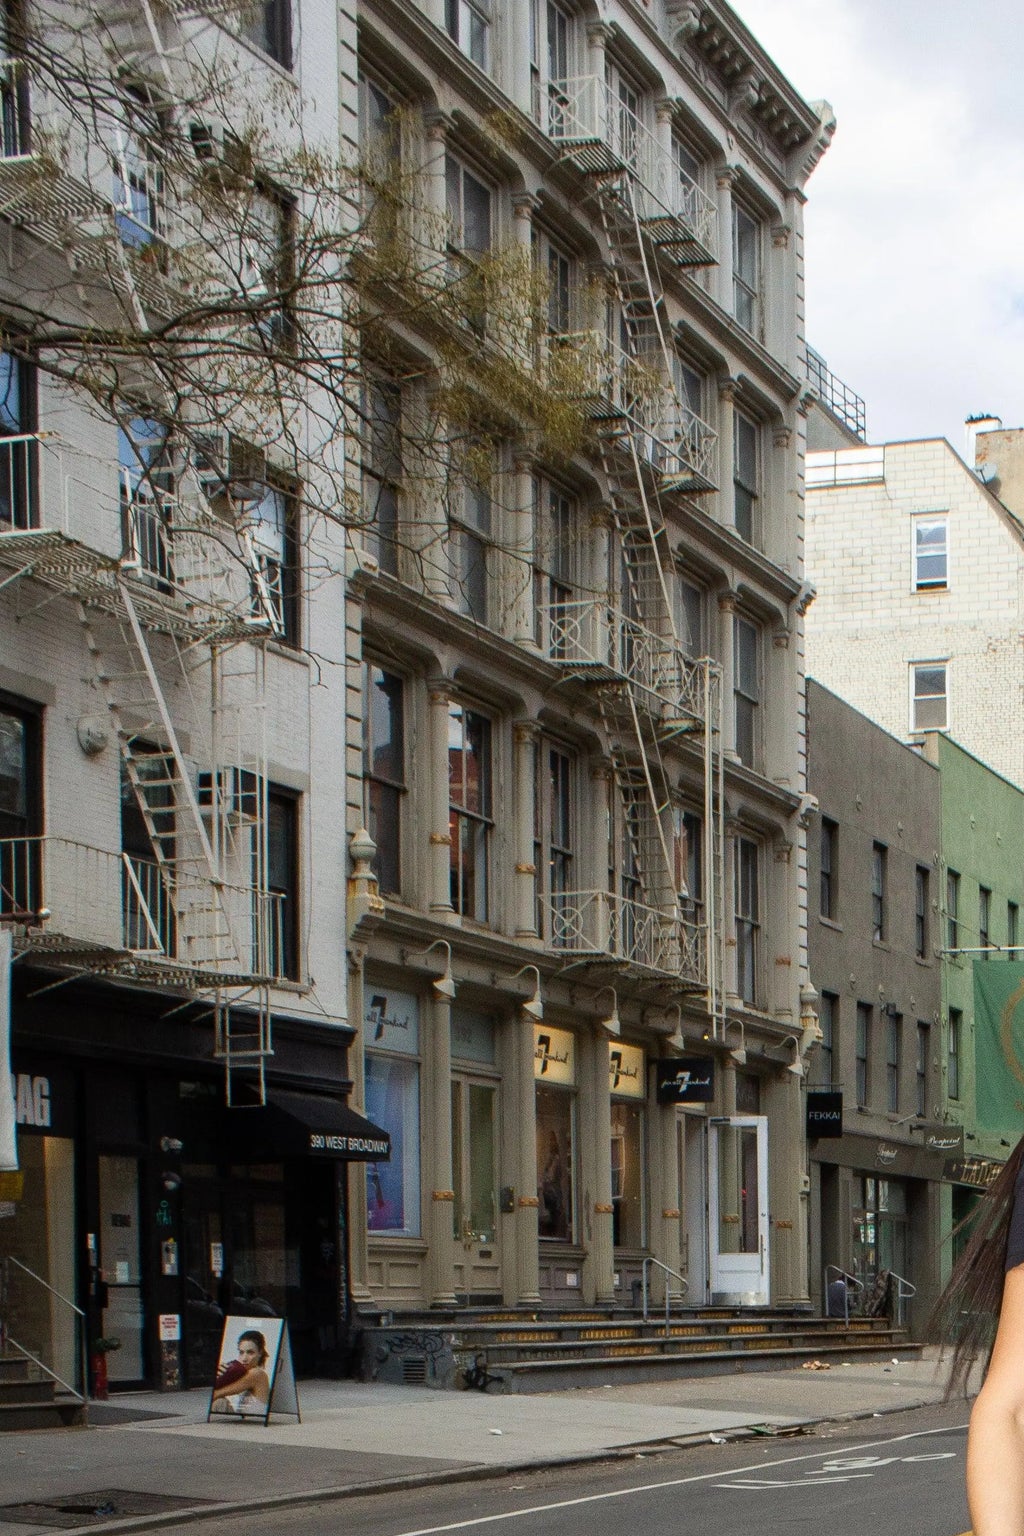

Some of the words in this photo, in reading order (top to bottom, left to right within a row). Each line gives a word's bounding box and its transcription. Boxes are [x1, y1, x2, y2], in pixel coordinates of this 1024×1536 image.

[371, 995, 387, 1041] 7
[538, 1034, 550, 1075] 7
[611, 1051, 622, 1089] 7
[676, 1071, 691, 1093] 7
[809, 1111, 841, 1120] FEKKAI
[310, 1134, 324, 1148] 390
[326, 1135, 347, 1150] WEST
[348, 1137, 388, 1153] BROADWAY
